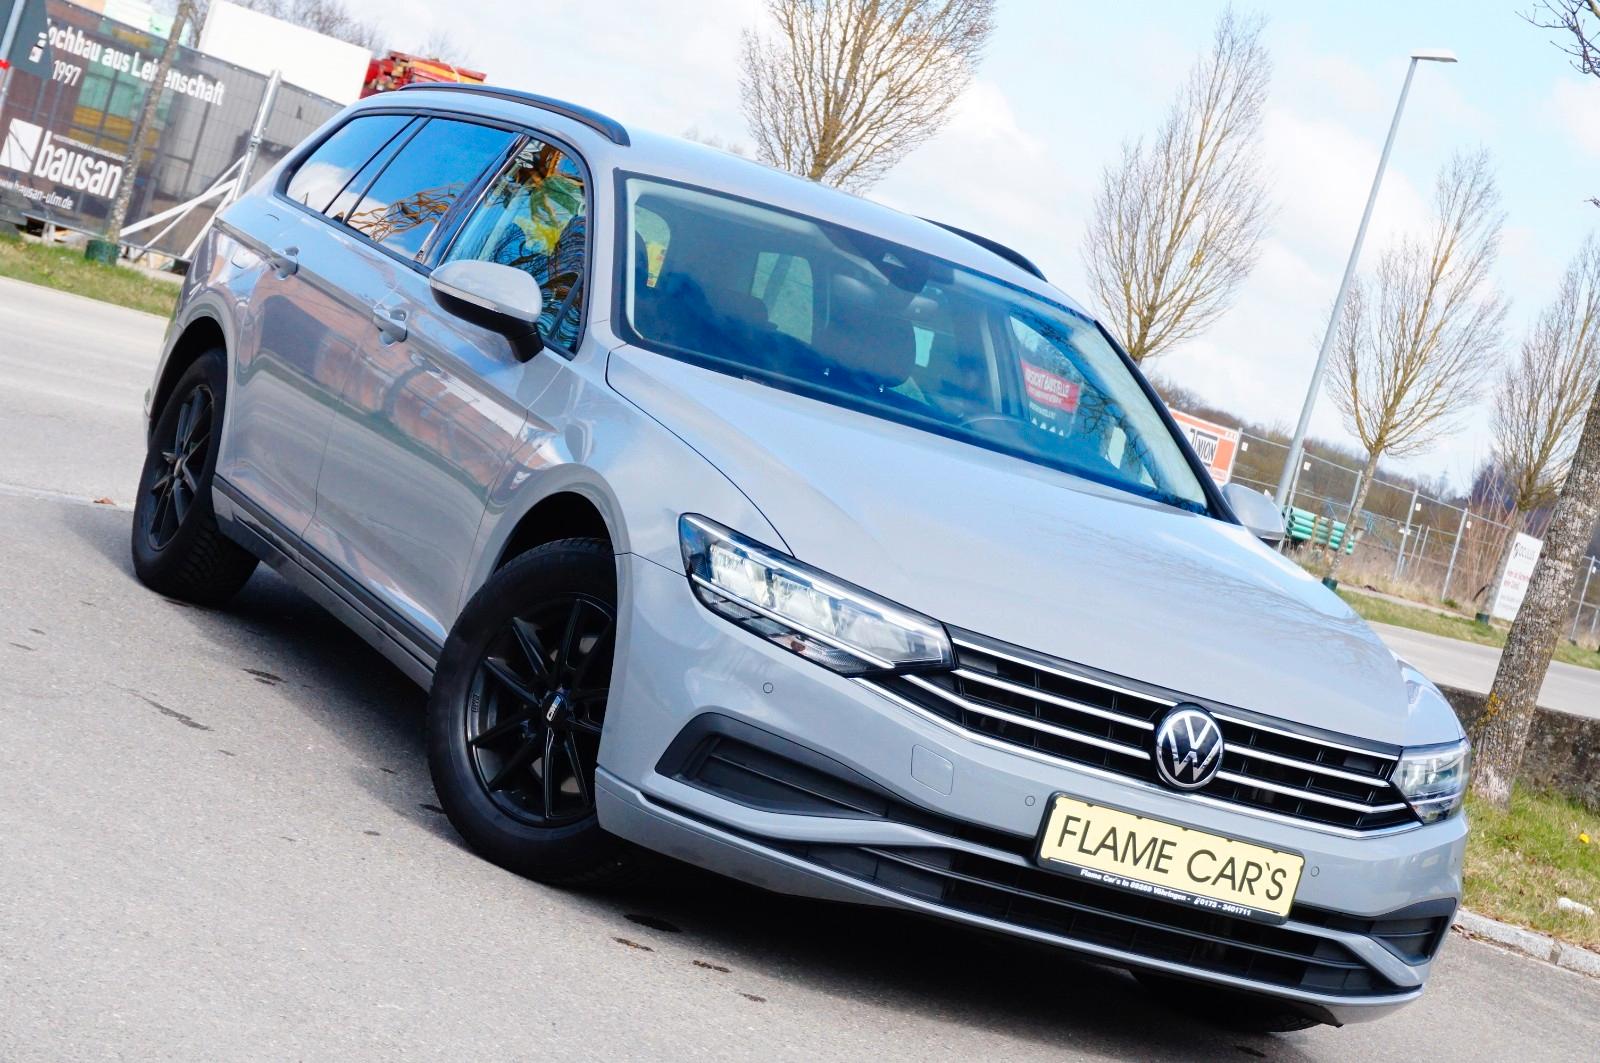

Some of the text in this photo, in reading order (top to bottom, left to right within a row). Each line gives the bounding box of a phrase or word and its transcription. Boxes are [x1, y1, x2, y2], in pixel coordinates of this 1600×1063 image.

[47, 18, 225, 106] ochbau aus Leienschaft
[52, 60, 83, 87] 1997
[33, 130, 123, 199] bausan
[1057, 814, 1177, 874] FLAME
[1080, 869, 1102, 880] Flame
